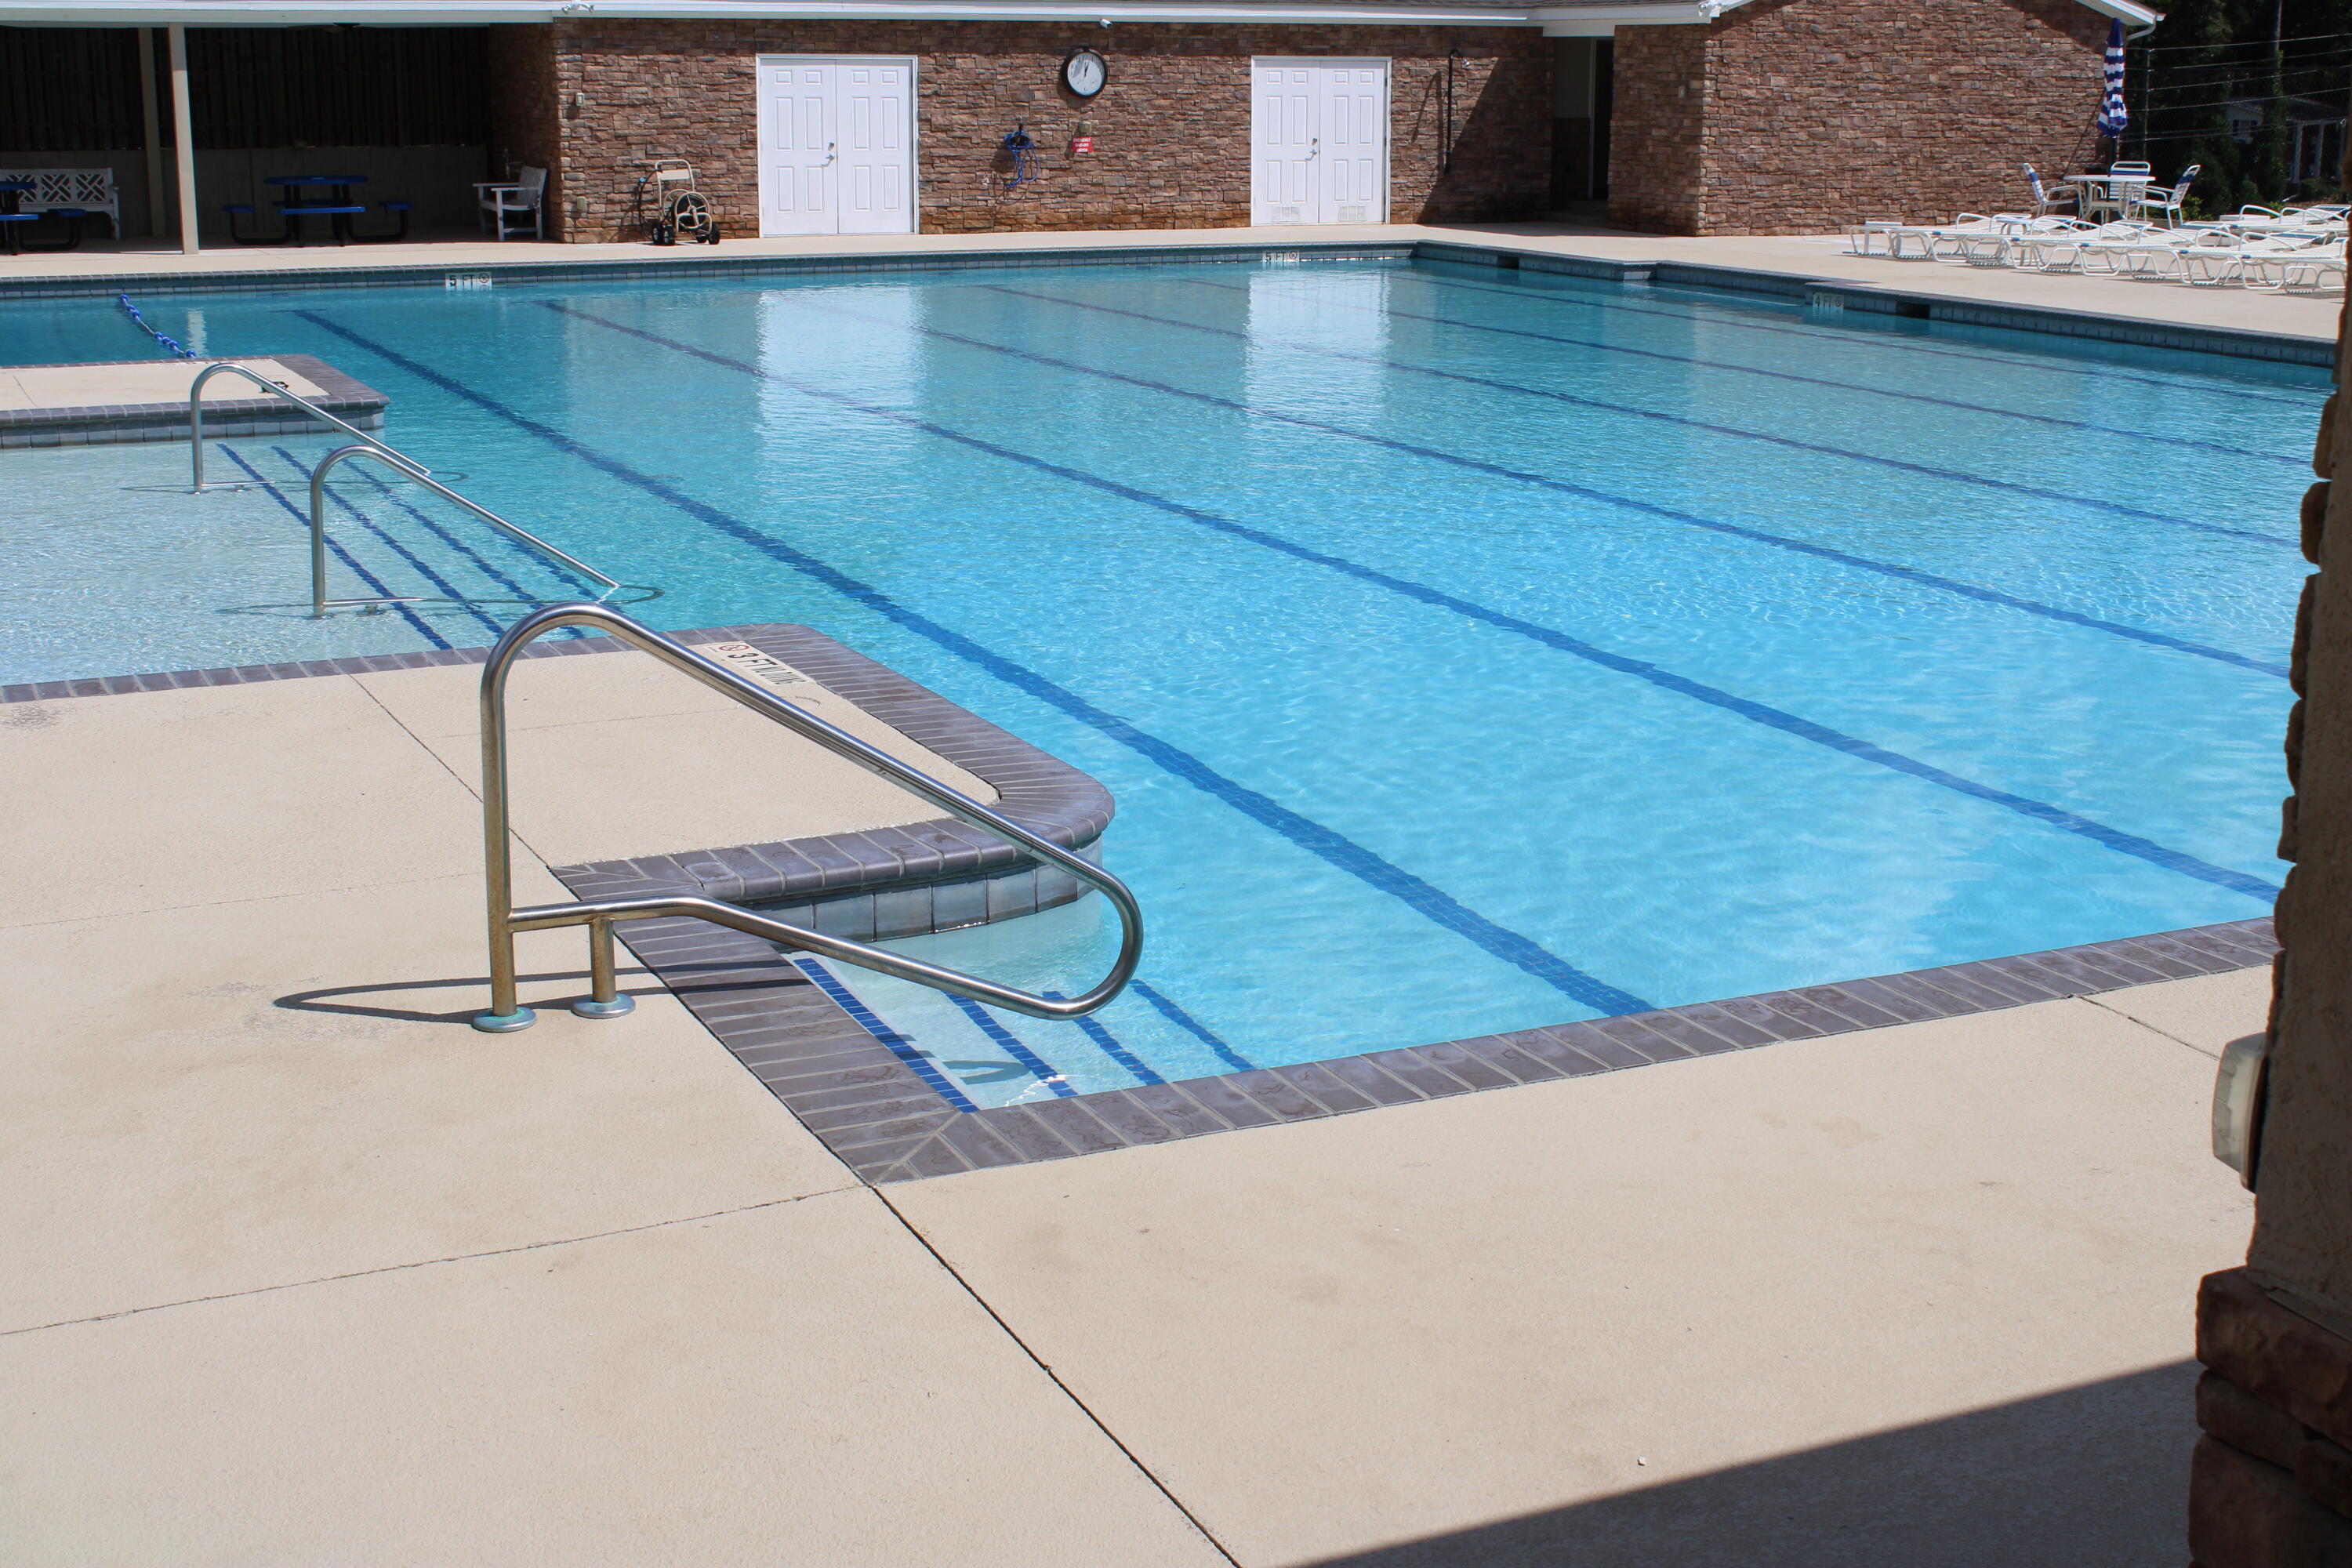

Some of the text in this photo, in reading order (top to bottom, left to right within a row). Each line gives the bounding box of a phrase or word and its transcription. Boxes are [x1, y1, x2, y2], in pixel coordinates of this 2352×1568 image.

[1265, 252, 1286, 263] 5 FT
[448, 274, 474, 290] 5 FT
[737, 659, 778, 667] FT
